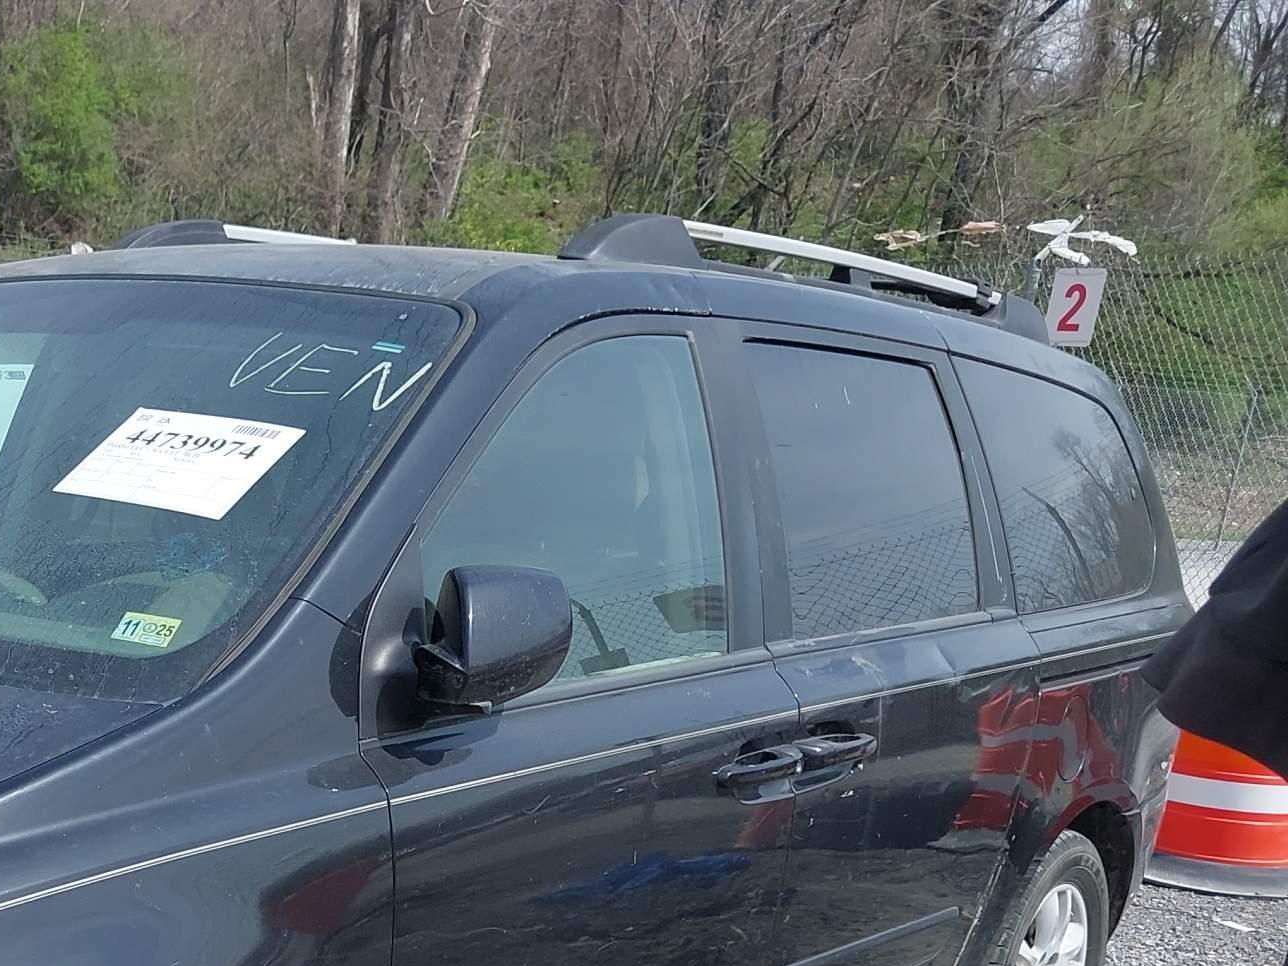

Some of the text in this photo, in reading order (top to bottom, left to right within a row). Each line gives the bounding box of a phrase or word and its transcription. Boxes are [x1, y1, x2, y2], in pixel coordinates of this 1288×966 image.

[1057, 283, 1087, 332] 2
[230, 332, 433, 411] VEN
[125, 429, 262, 460] 44739974
[121, 619, 176, 637] 11 25
